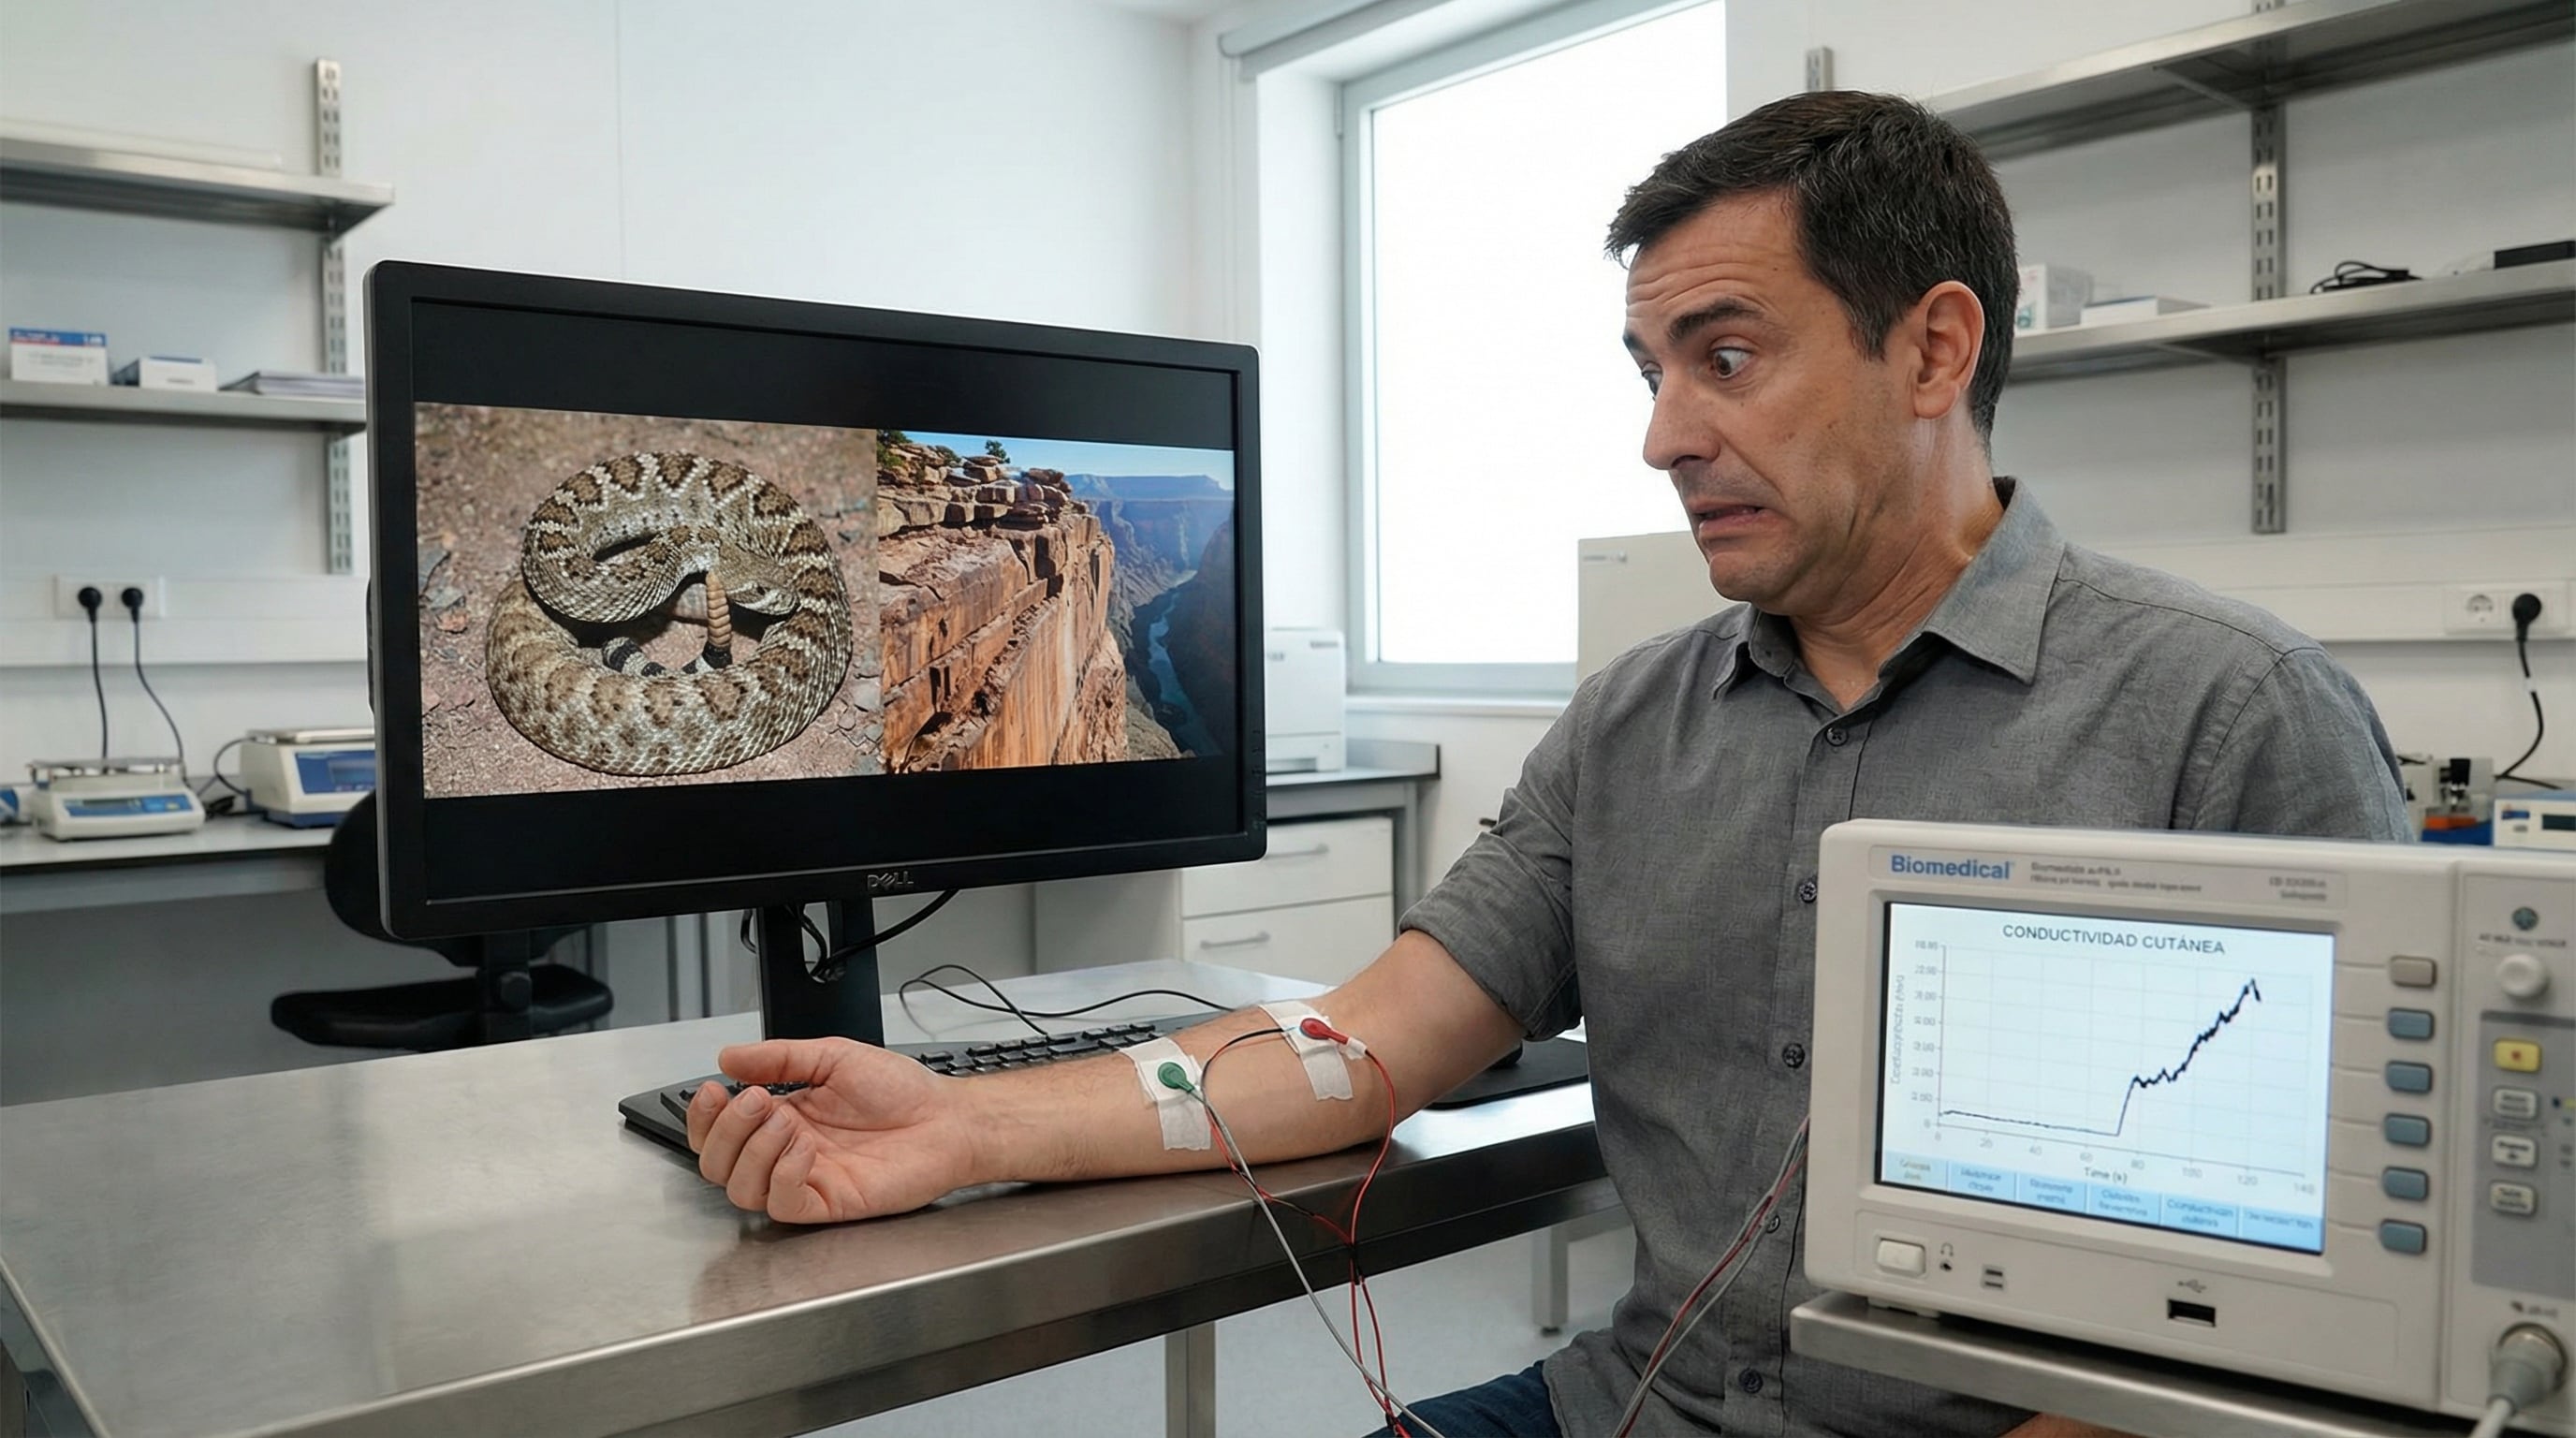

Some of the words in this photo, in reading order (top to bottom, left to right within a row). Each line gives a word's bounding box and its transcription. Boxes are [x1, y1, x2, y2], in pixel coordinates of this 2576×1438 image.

[1891, 855, 2010, 879] Biomedical
[867, 871, 914, 888] DELL
[2002, 925, 2137, 947] CONDUCTIVIDAD
[2142, 934, 2225, 954] CUTÁNEA
[2029, 1145, 2042, 1155] 40
[2080, 1152, 2093, 1163] 60
[2131, 1159, 2145, 1170] 80
[2237, 1174, 2258, 1186] 120
